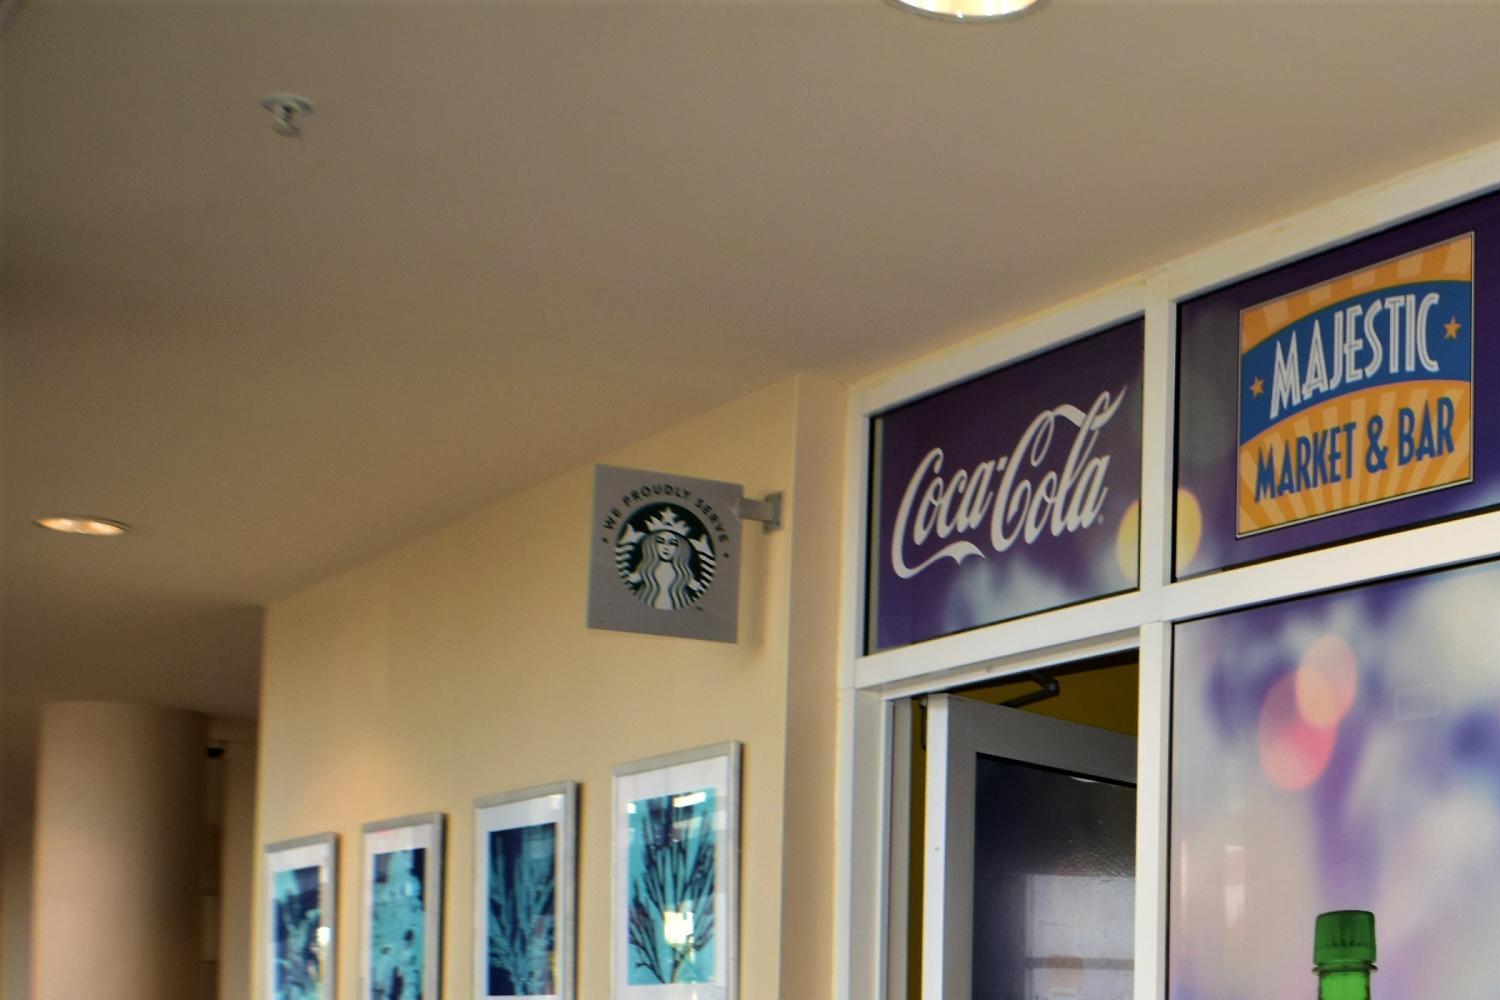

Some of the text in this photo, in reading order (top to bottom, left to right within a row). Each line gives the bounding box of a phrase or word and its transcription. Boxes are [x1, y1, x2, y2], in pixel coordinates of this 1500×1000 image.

[1269, 292, 1440, 420] MAJESTIC
[891, 385, 1127, 579] Coca-Cola
[1254, 396, 1455, 503] MARKET & BAR
[603, 484, 730, 543] WE PROUDLY SERVE
